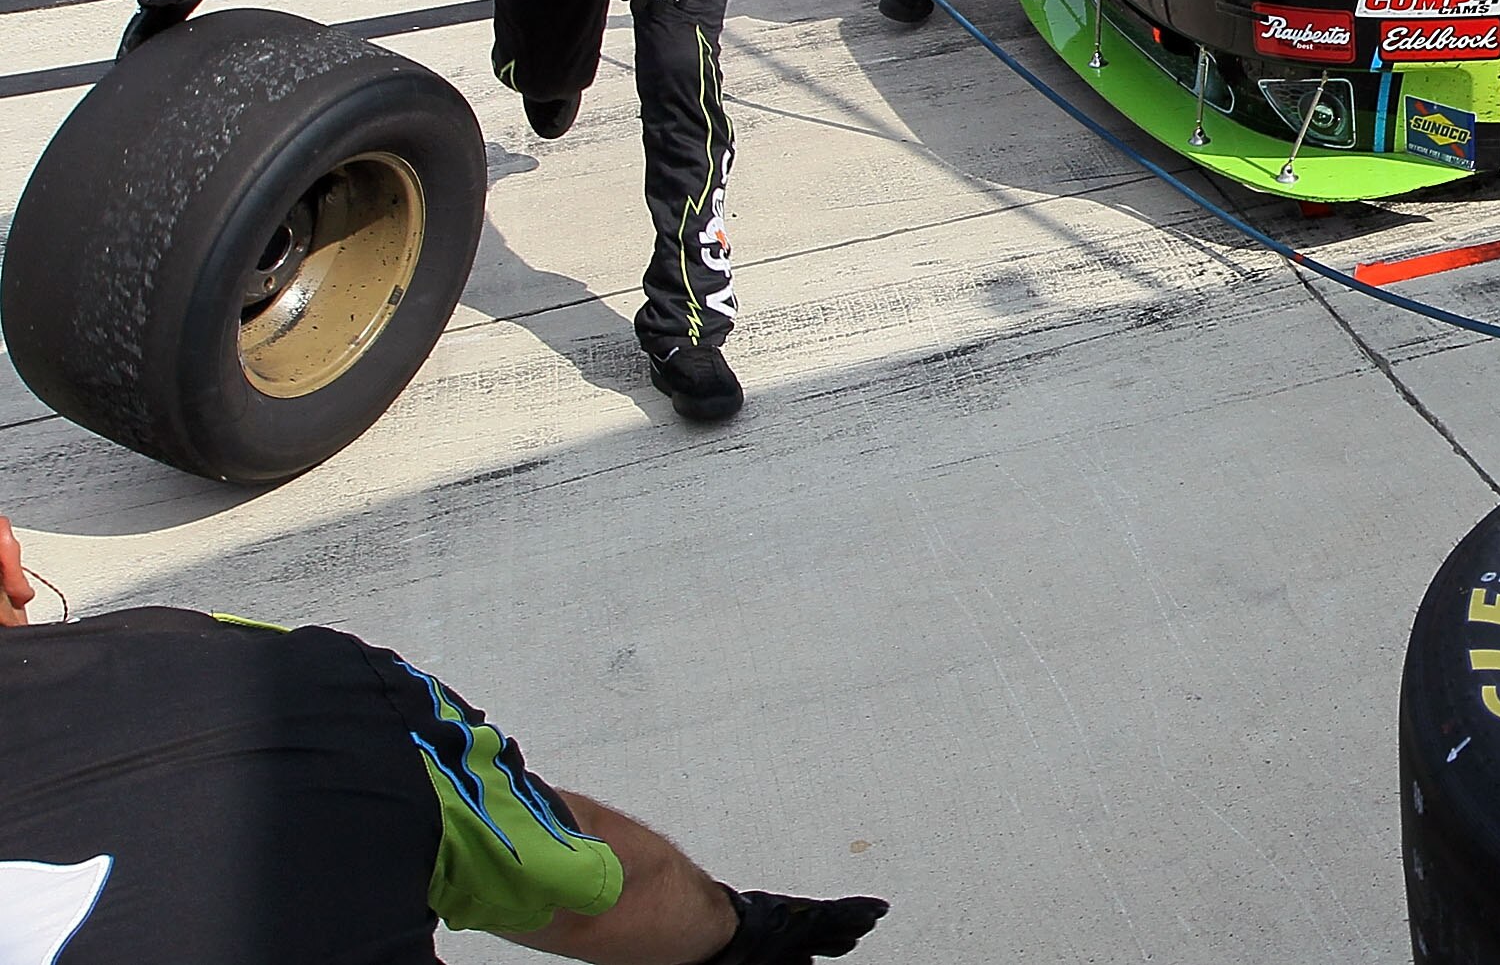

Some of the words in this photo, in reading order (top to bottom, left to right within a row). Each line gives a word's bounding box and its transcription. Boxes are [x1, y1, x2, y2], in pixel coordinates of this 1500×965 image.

[1438, 4, 1491, 16] CAMS
[1382, 27, 1499, 51] Edelbrock
[1412, 116, 1470, 142] SUNOCO
